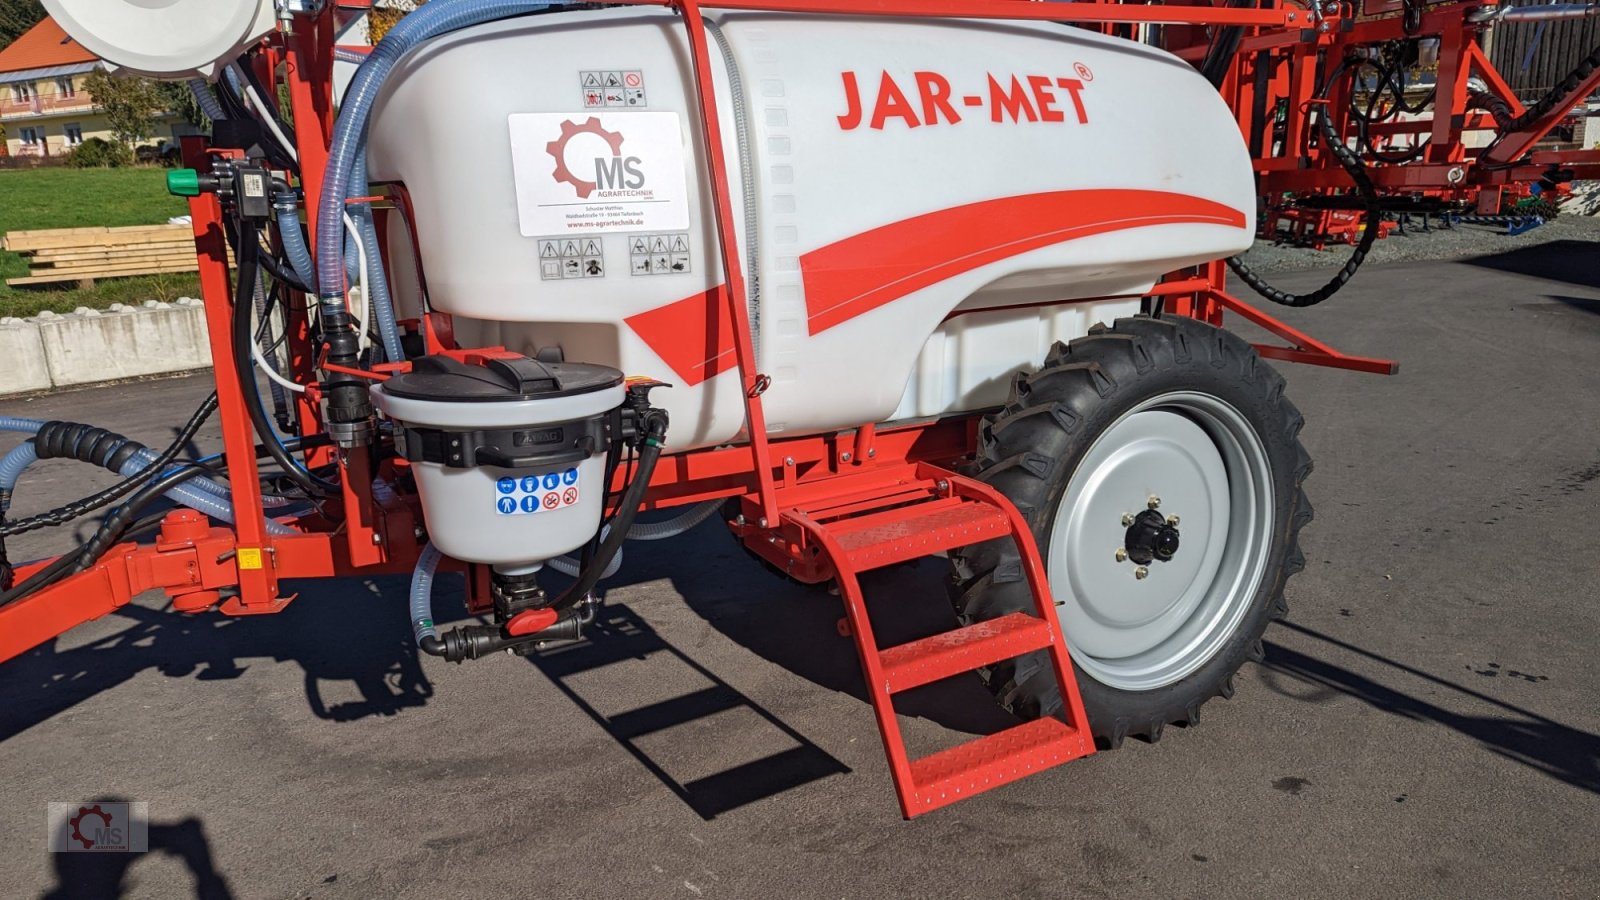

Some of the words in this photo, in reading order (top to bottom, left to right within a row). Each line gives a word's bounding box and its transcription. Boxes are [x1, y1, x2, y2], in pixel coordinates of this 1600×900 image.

[836, 69, 1089, 131] JAR-MET
[594, 156, 645, 189] MS
[597, 190, 653, 198] AGRARTECHNIK
[567, 218, 644, 228] www.ms-agrartechnik.de
